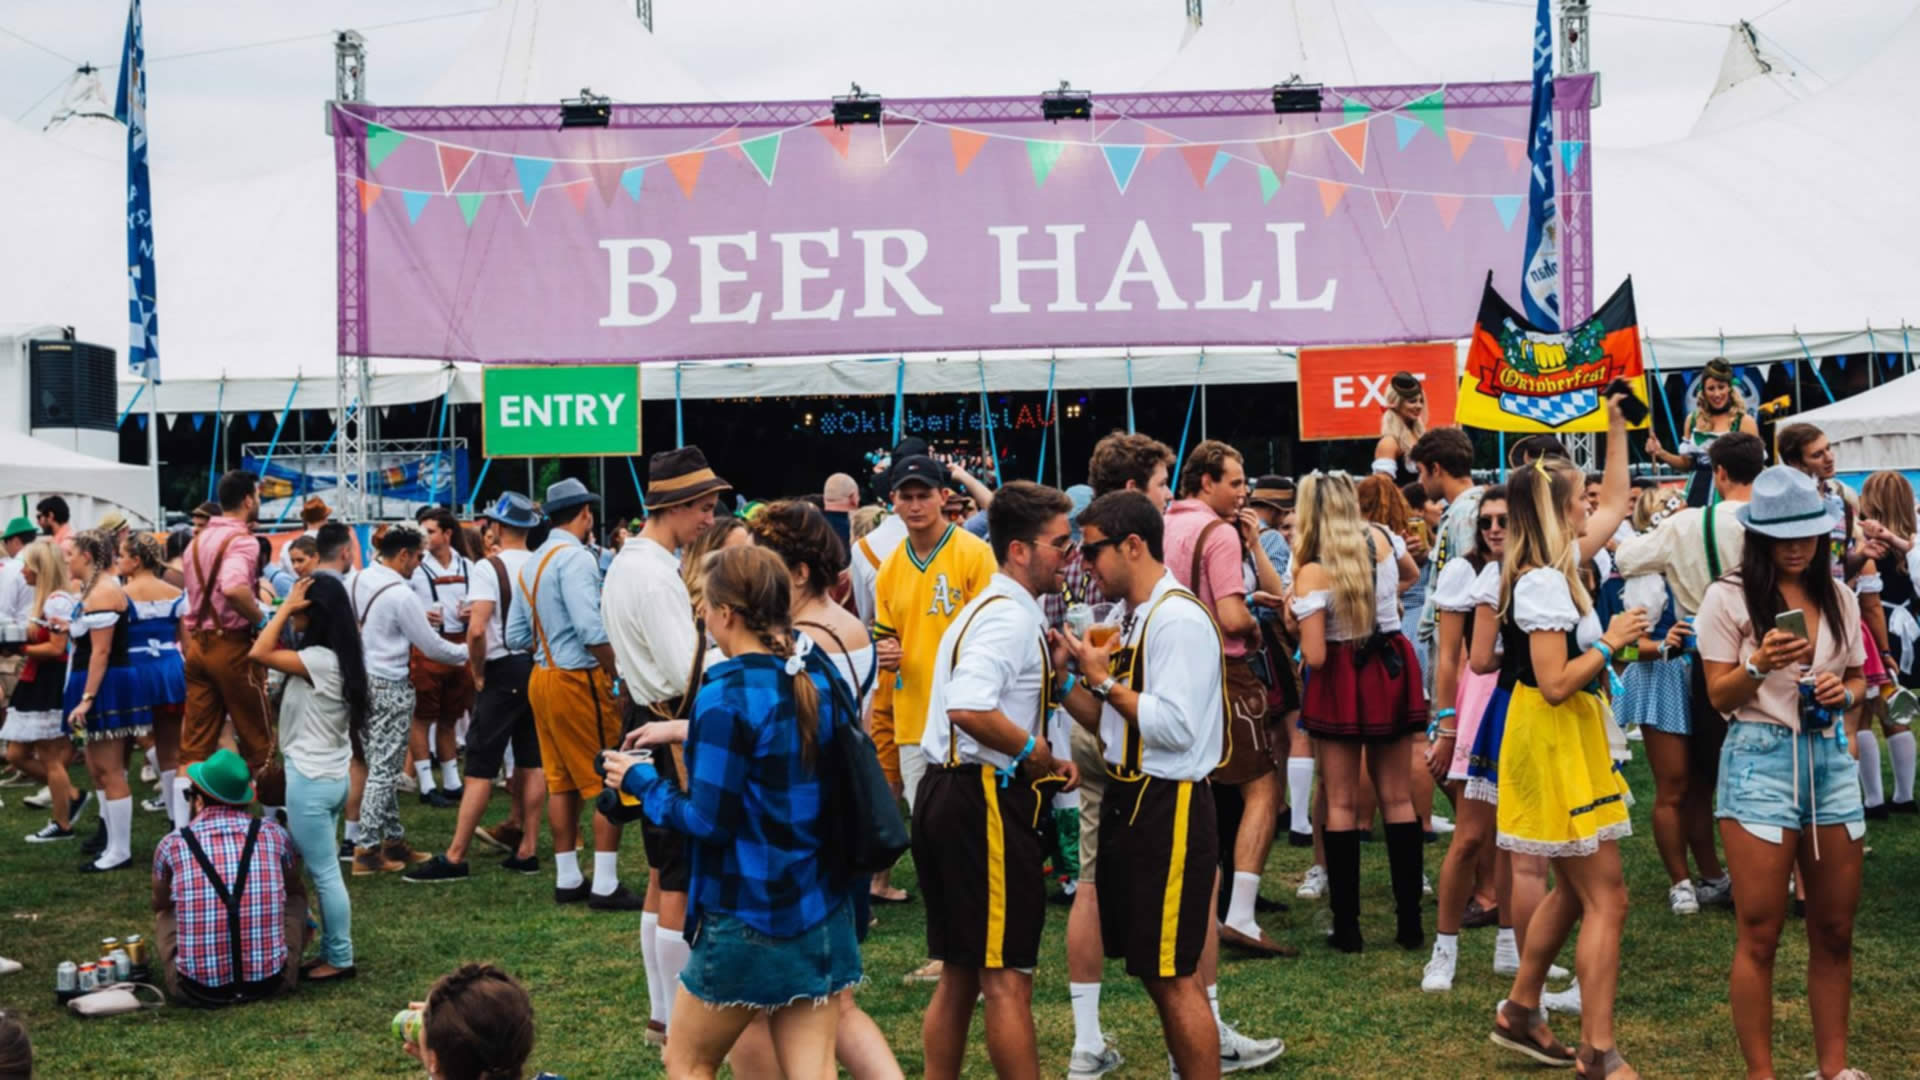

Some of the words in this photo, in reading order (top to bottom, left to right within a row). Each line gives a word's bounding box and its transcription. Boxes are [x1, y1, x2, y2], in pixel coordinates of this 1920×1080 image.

[598, 227, 944, 327] BEER
[988, 220, 1338, 313] HALL
[1333, 372, 1426, 408] EX
[1500, 365, 1606, 393] Oktoberfest
[500, 393, 626, 427] ENTRY
[820, 403, 1056, 434] #OktberfestAU
